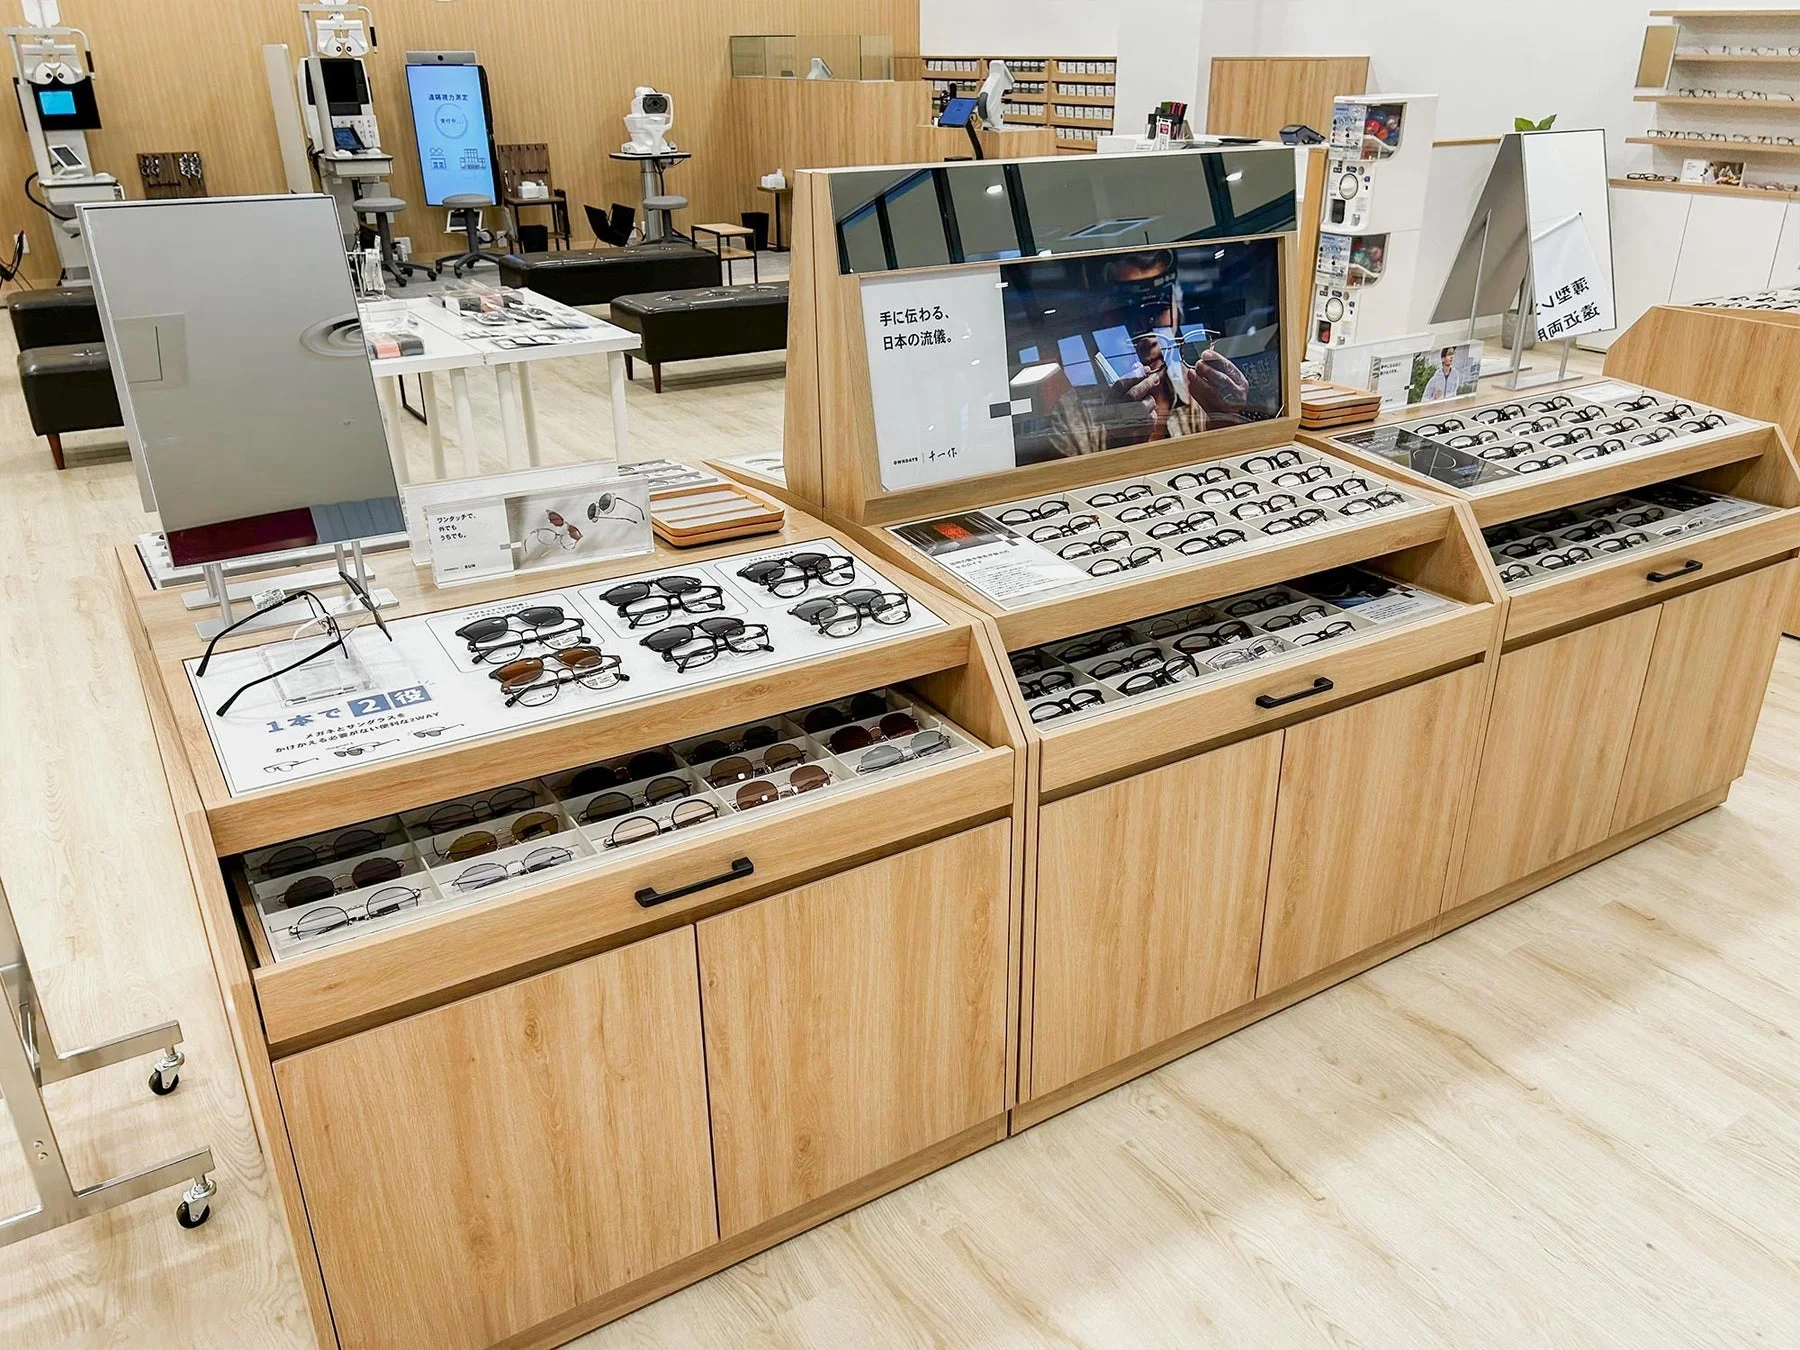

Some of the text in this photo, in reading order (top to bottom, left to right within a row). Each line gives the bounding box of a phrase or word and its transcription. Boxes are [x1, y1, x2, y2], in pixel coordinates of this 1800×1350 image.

[879, 305, 950, 327] 手に伝わる、
[883, 329, 952, 351] 日本の流儀。
